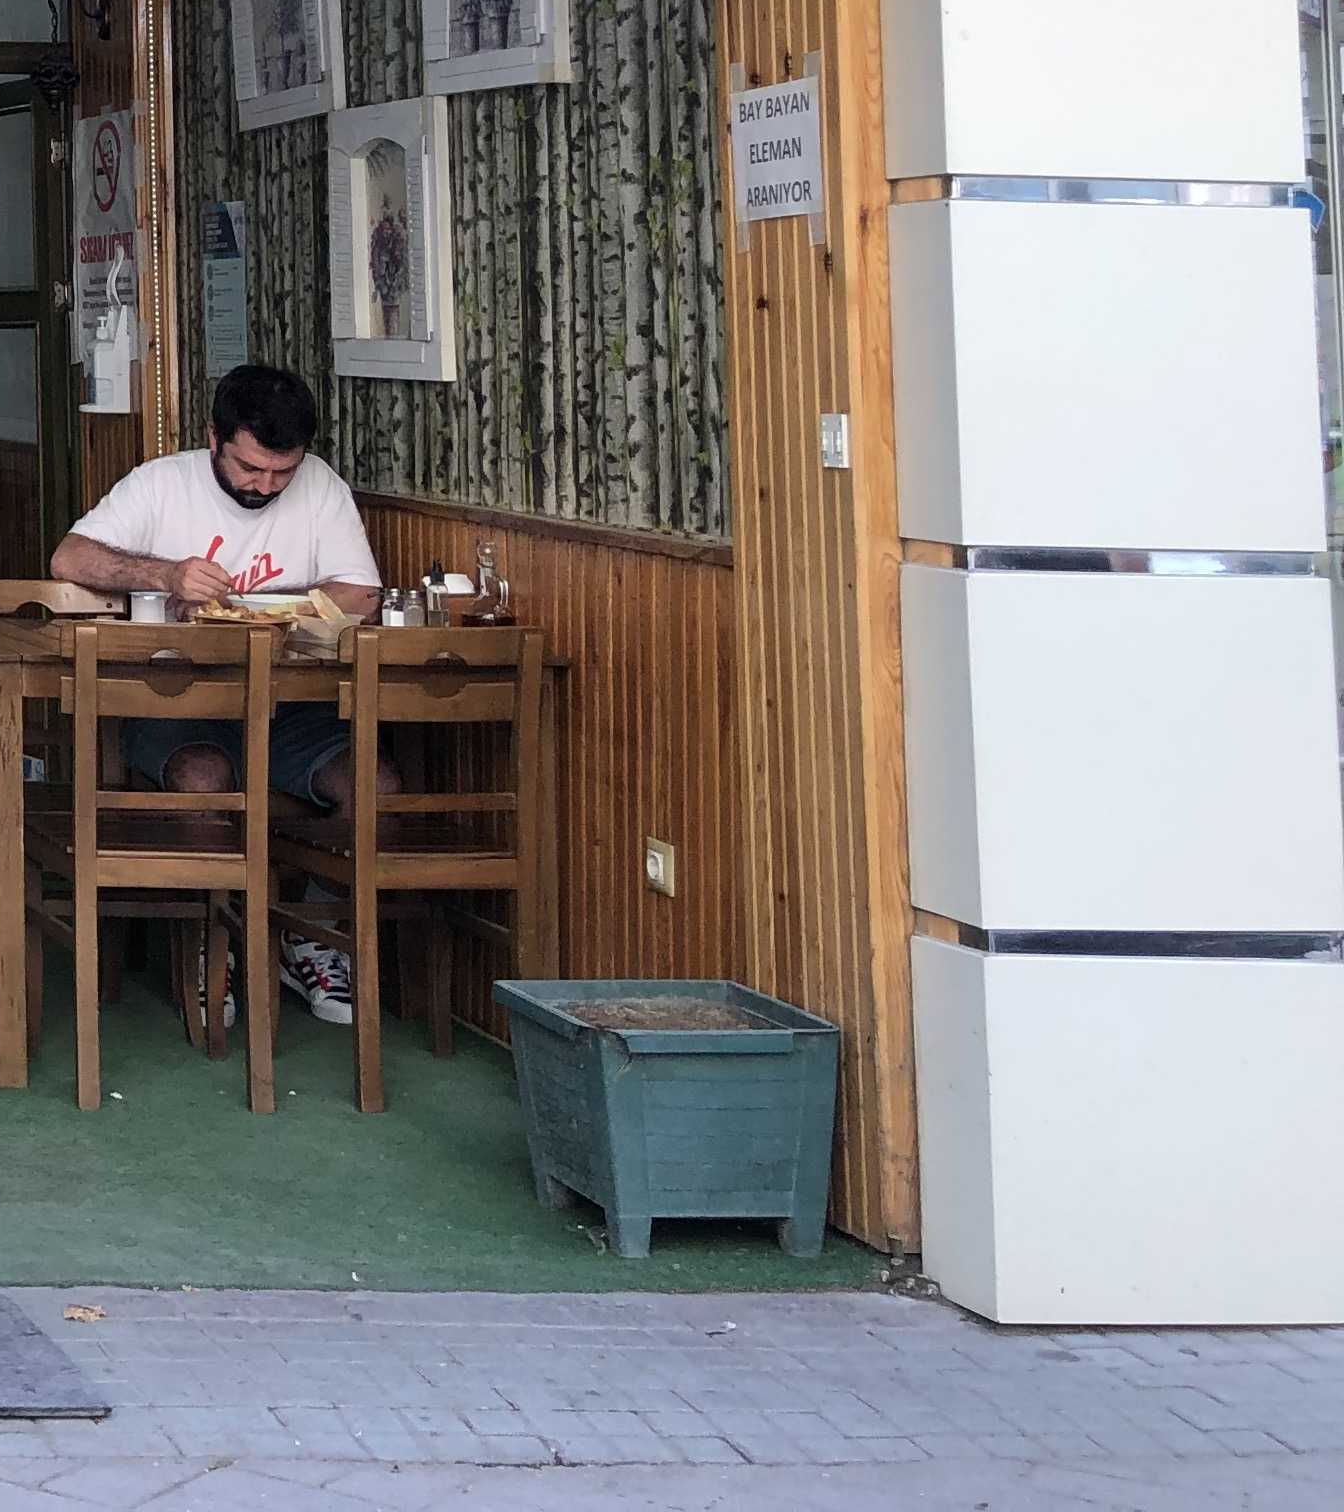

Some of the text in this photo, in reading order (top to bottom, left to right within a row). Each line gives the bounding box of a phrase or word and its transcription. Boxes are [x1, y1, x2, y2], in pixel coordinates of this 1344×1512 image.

[739, 91, 810, 124] BAY BAYAN
[749, 136, 802, 165] ELEMAN
[746, 180, 812, 208] ARANIYOR
